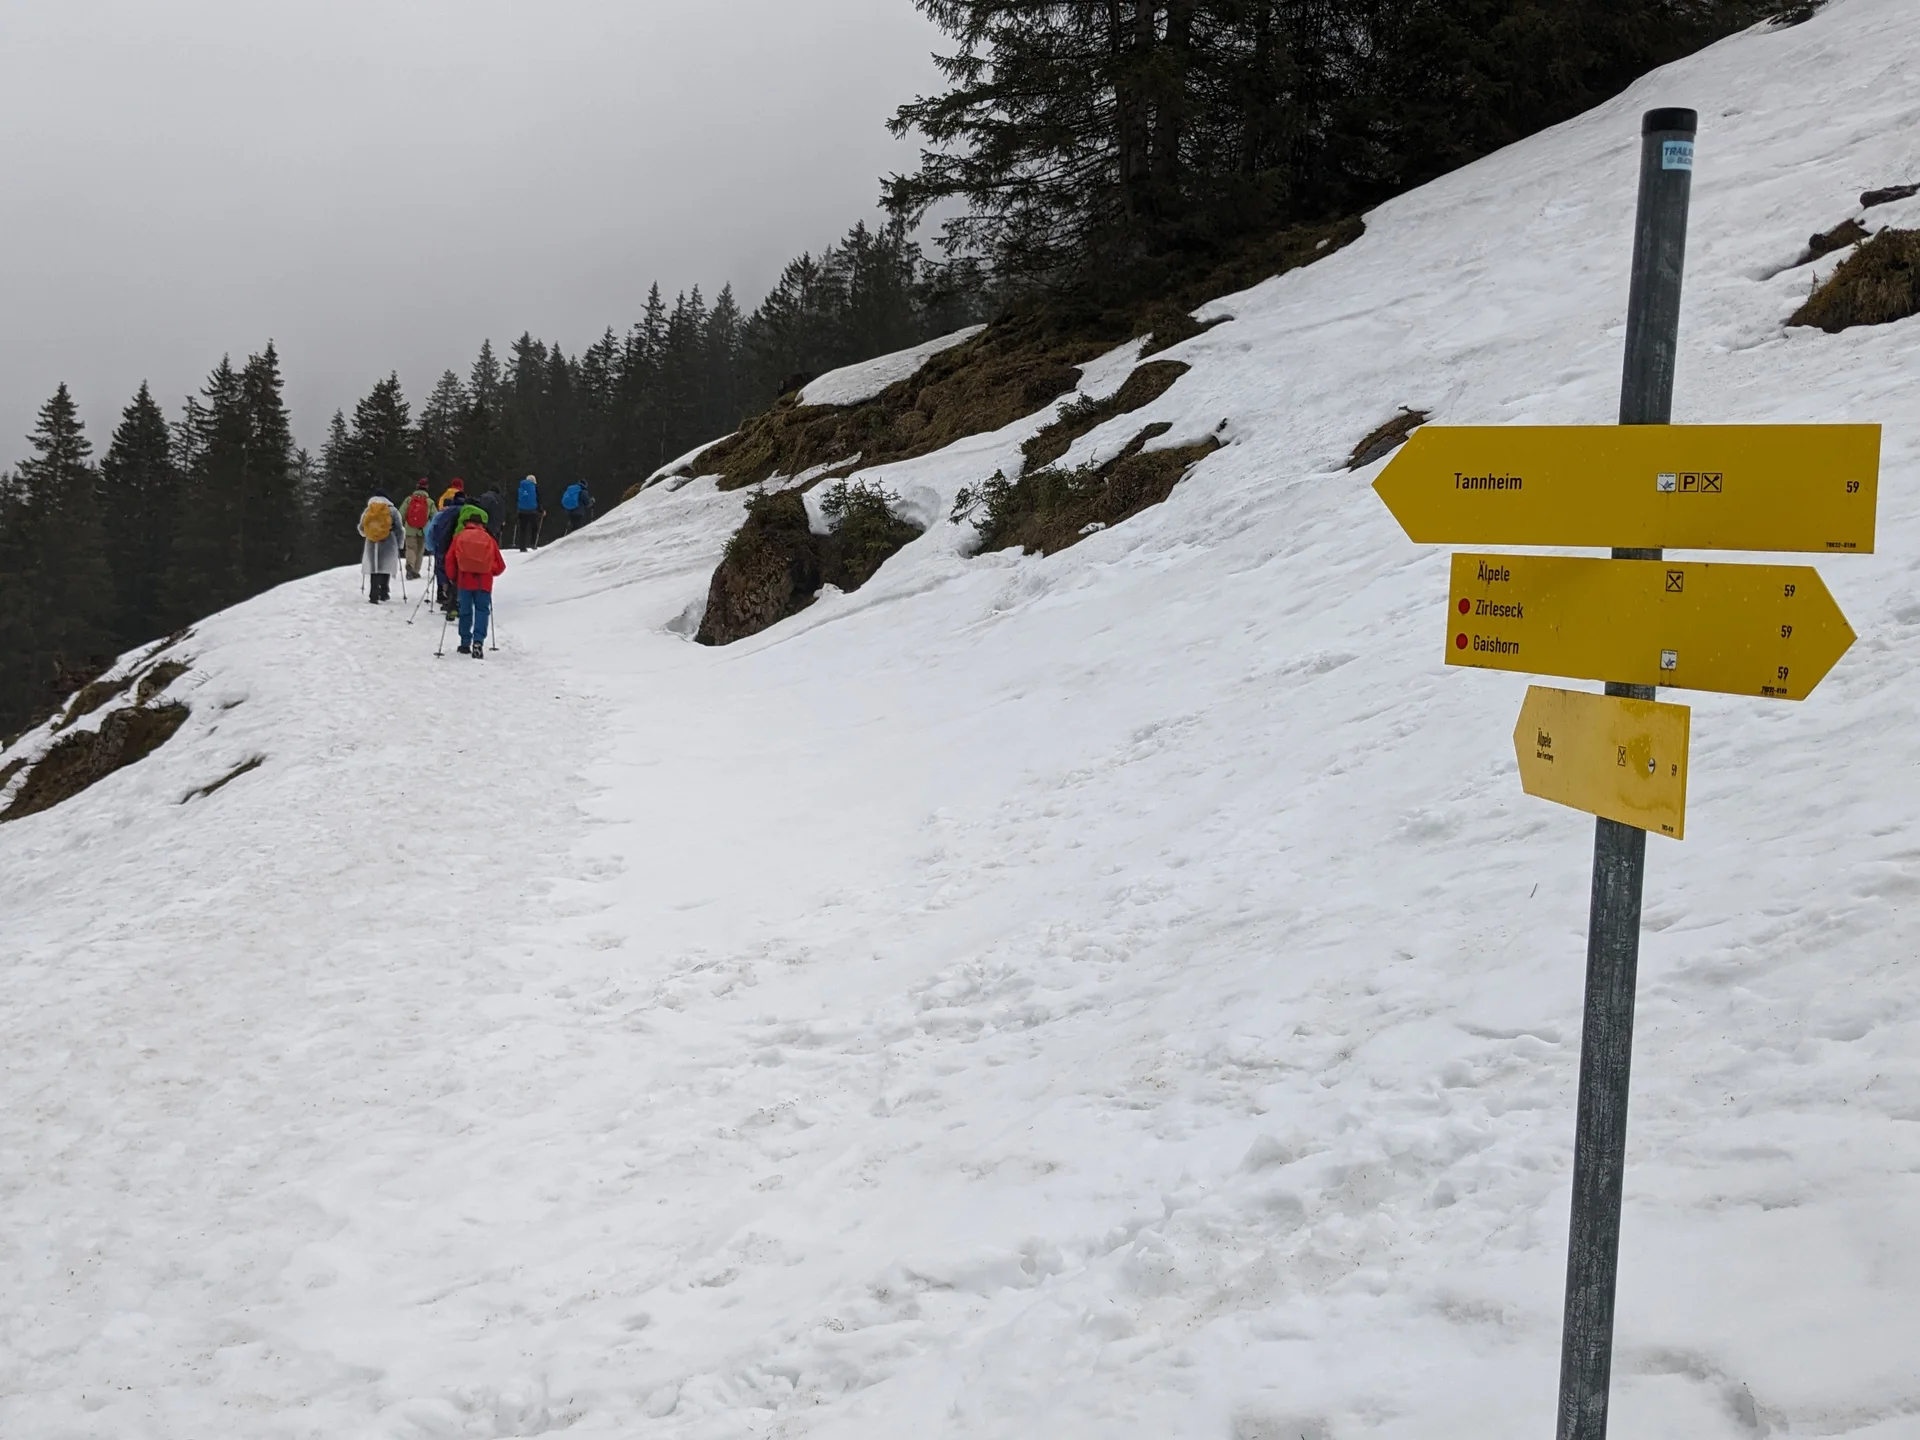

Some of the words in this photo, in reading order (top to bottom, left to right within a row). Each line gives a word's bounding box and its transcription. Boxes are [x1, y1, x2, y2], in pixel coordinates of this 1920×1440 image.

[1454, 472, 1523, 490] Tannheim
[1682, 475, 1696, 490] P
[1846, 481, 1860, 494] 59
[1477, 560, 1510, 585] Älpele
[1784, 584, 1796, 597] 59
[1475, 599, 1524, 618] Zirleseck
[1781, 625, 1793, 639] 59
[1473, 634, 1519, 654] Gaishorn
[1777, 667, 1789, 681] 59
[1671, 763, 1678, 777] 59
